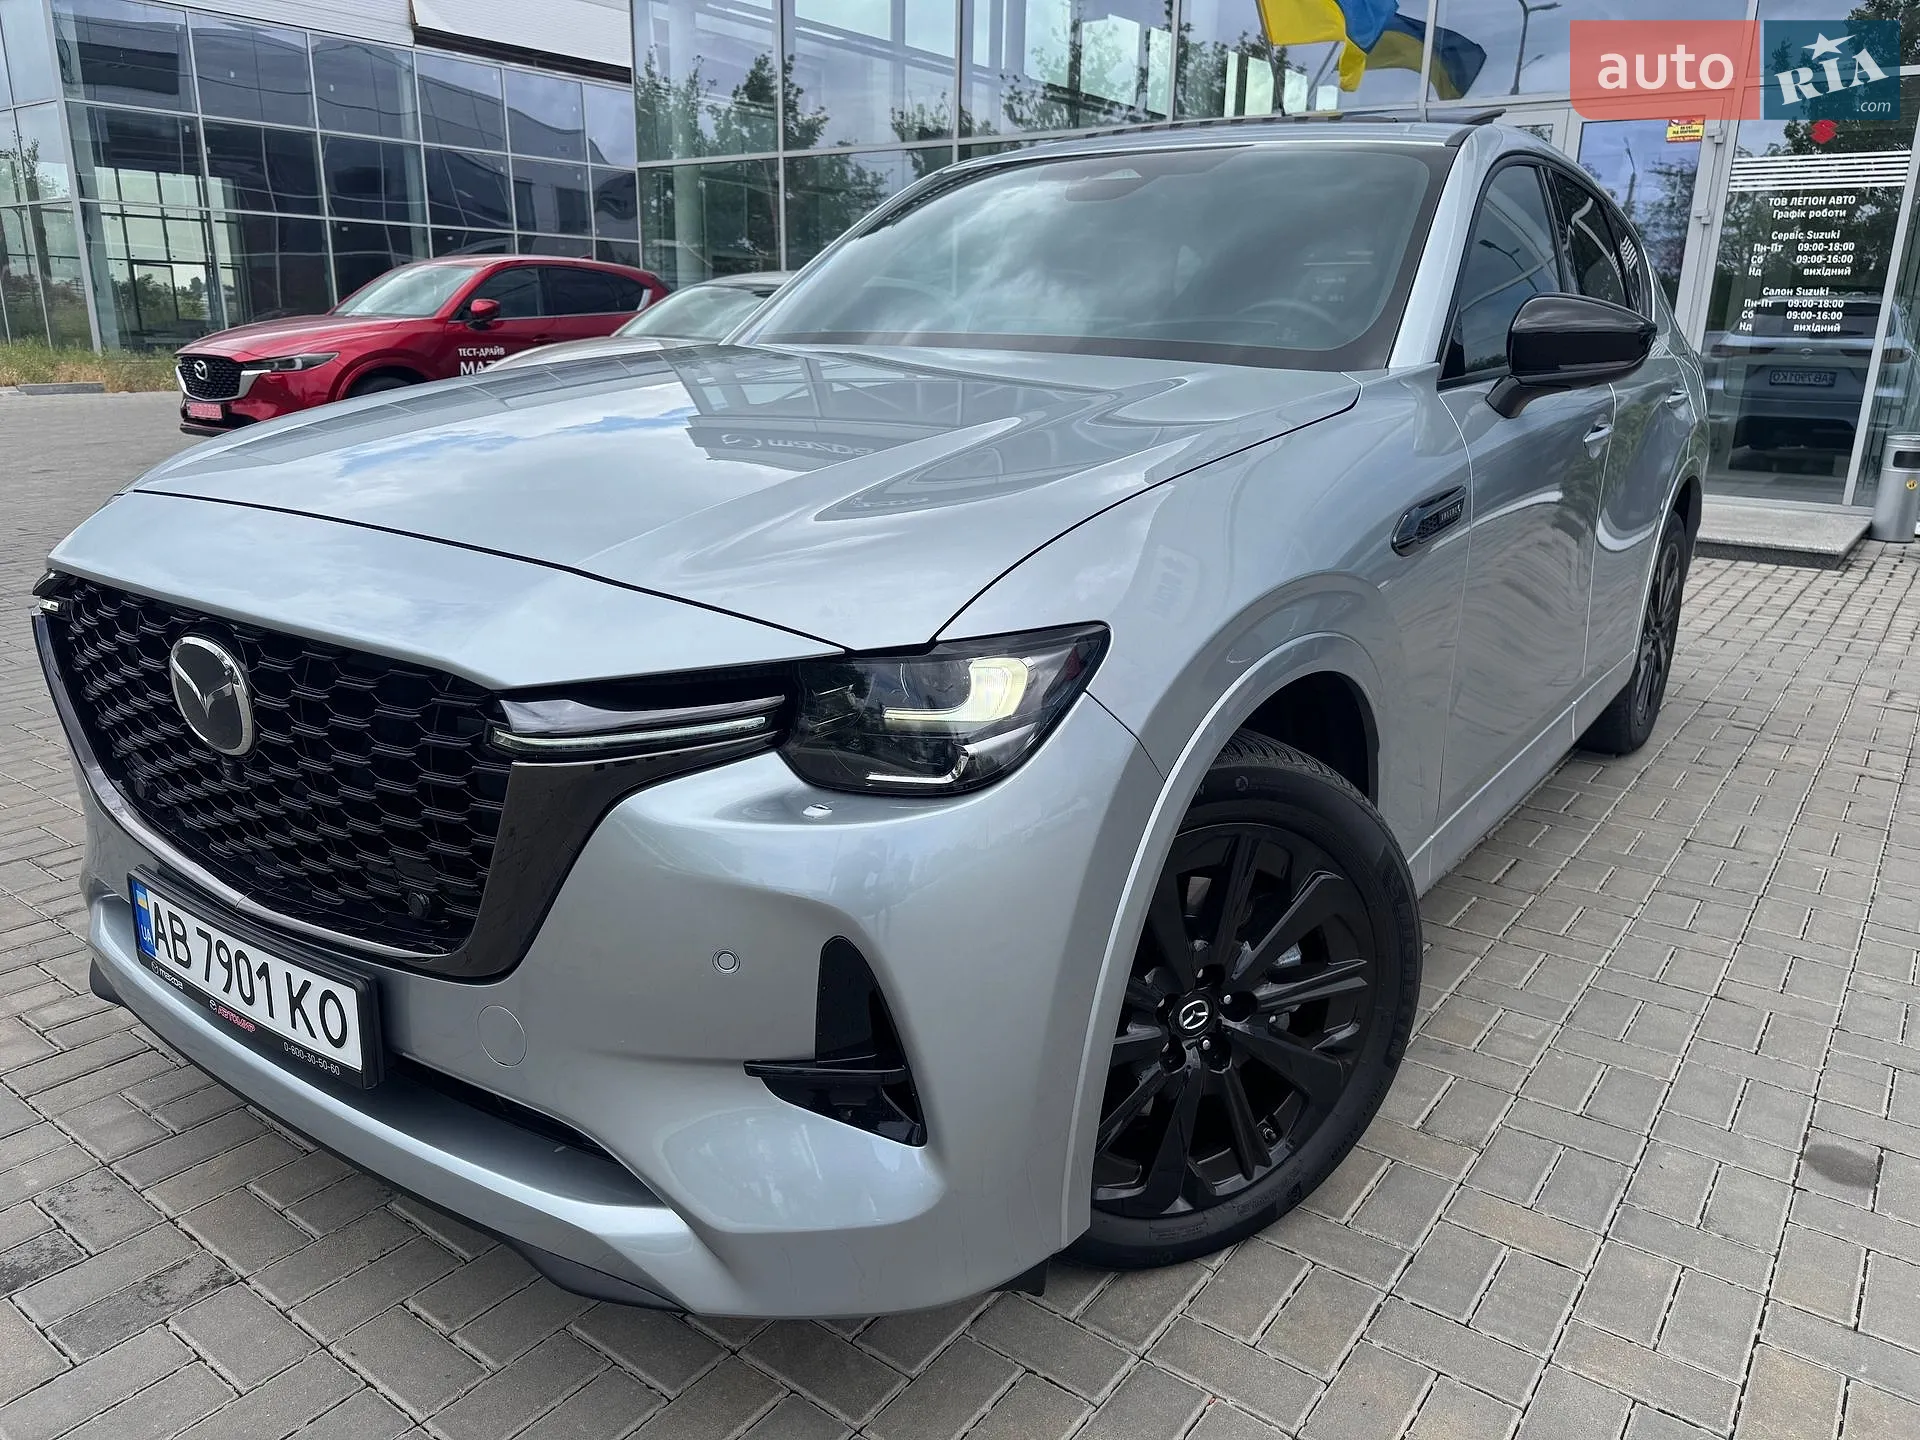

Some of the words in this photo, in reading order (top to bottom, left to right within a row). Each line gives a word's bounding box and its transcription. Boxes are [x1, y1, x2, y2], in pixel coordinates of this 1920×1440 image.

[1768, 197, 1788, 207] ТОВ
[1789, 196, 1826, 206] ЛЕГІОН
[1828, 195, 1856, 205] АВТО
[1772, 208, 1806, 220] Графік
[1808, 207, 1847, 219] роботи
[1771, 230, 1804, 241] Сервіс
[1806, 229, 1841, 240] Suzuki
[1753, 243, 1784, 252] Пн-Пт
[1797, 242, 1855, 251] 09:00-18:00
[1751, 254, 1764, 264] Сб
[1796, 254, 1854, 264] 09:00-16:00
[1748, 266, 1762, 277] Нд
[1803, 266, 1852, 277] вихідний
[1762, 286, 1793, 296] Салон
[1795, 286, 1829, 296] Suzuki
[1744, 298, 1774, 308] Пн-Пт
[1787, 299, 1844, 308] 09:00-18:00
[1741, 310, 1755, 319] Сб
[1786, 311, 1843, 320] 09:00-16:00
[1739, 322, 1752, 331] Нд
[1793, 322, 1841, 332] вихідний
[458, 345, 506, 357] ТЕСТ-ДРАЙВ
[460, 360, 496, 376] MA
[141, 923, 153, 946] UA
[154, 901, 192, 970] AB
[196, 926, 275, 1020] 7901
[285, 971, 348, 1049] KO
